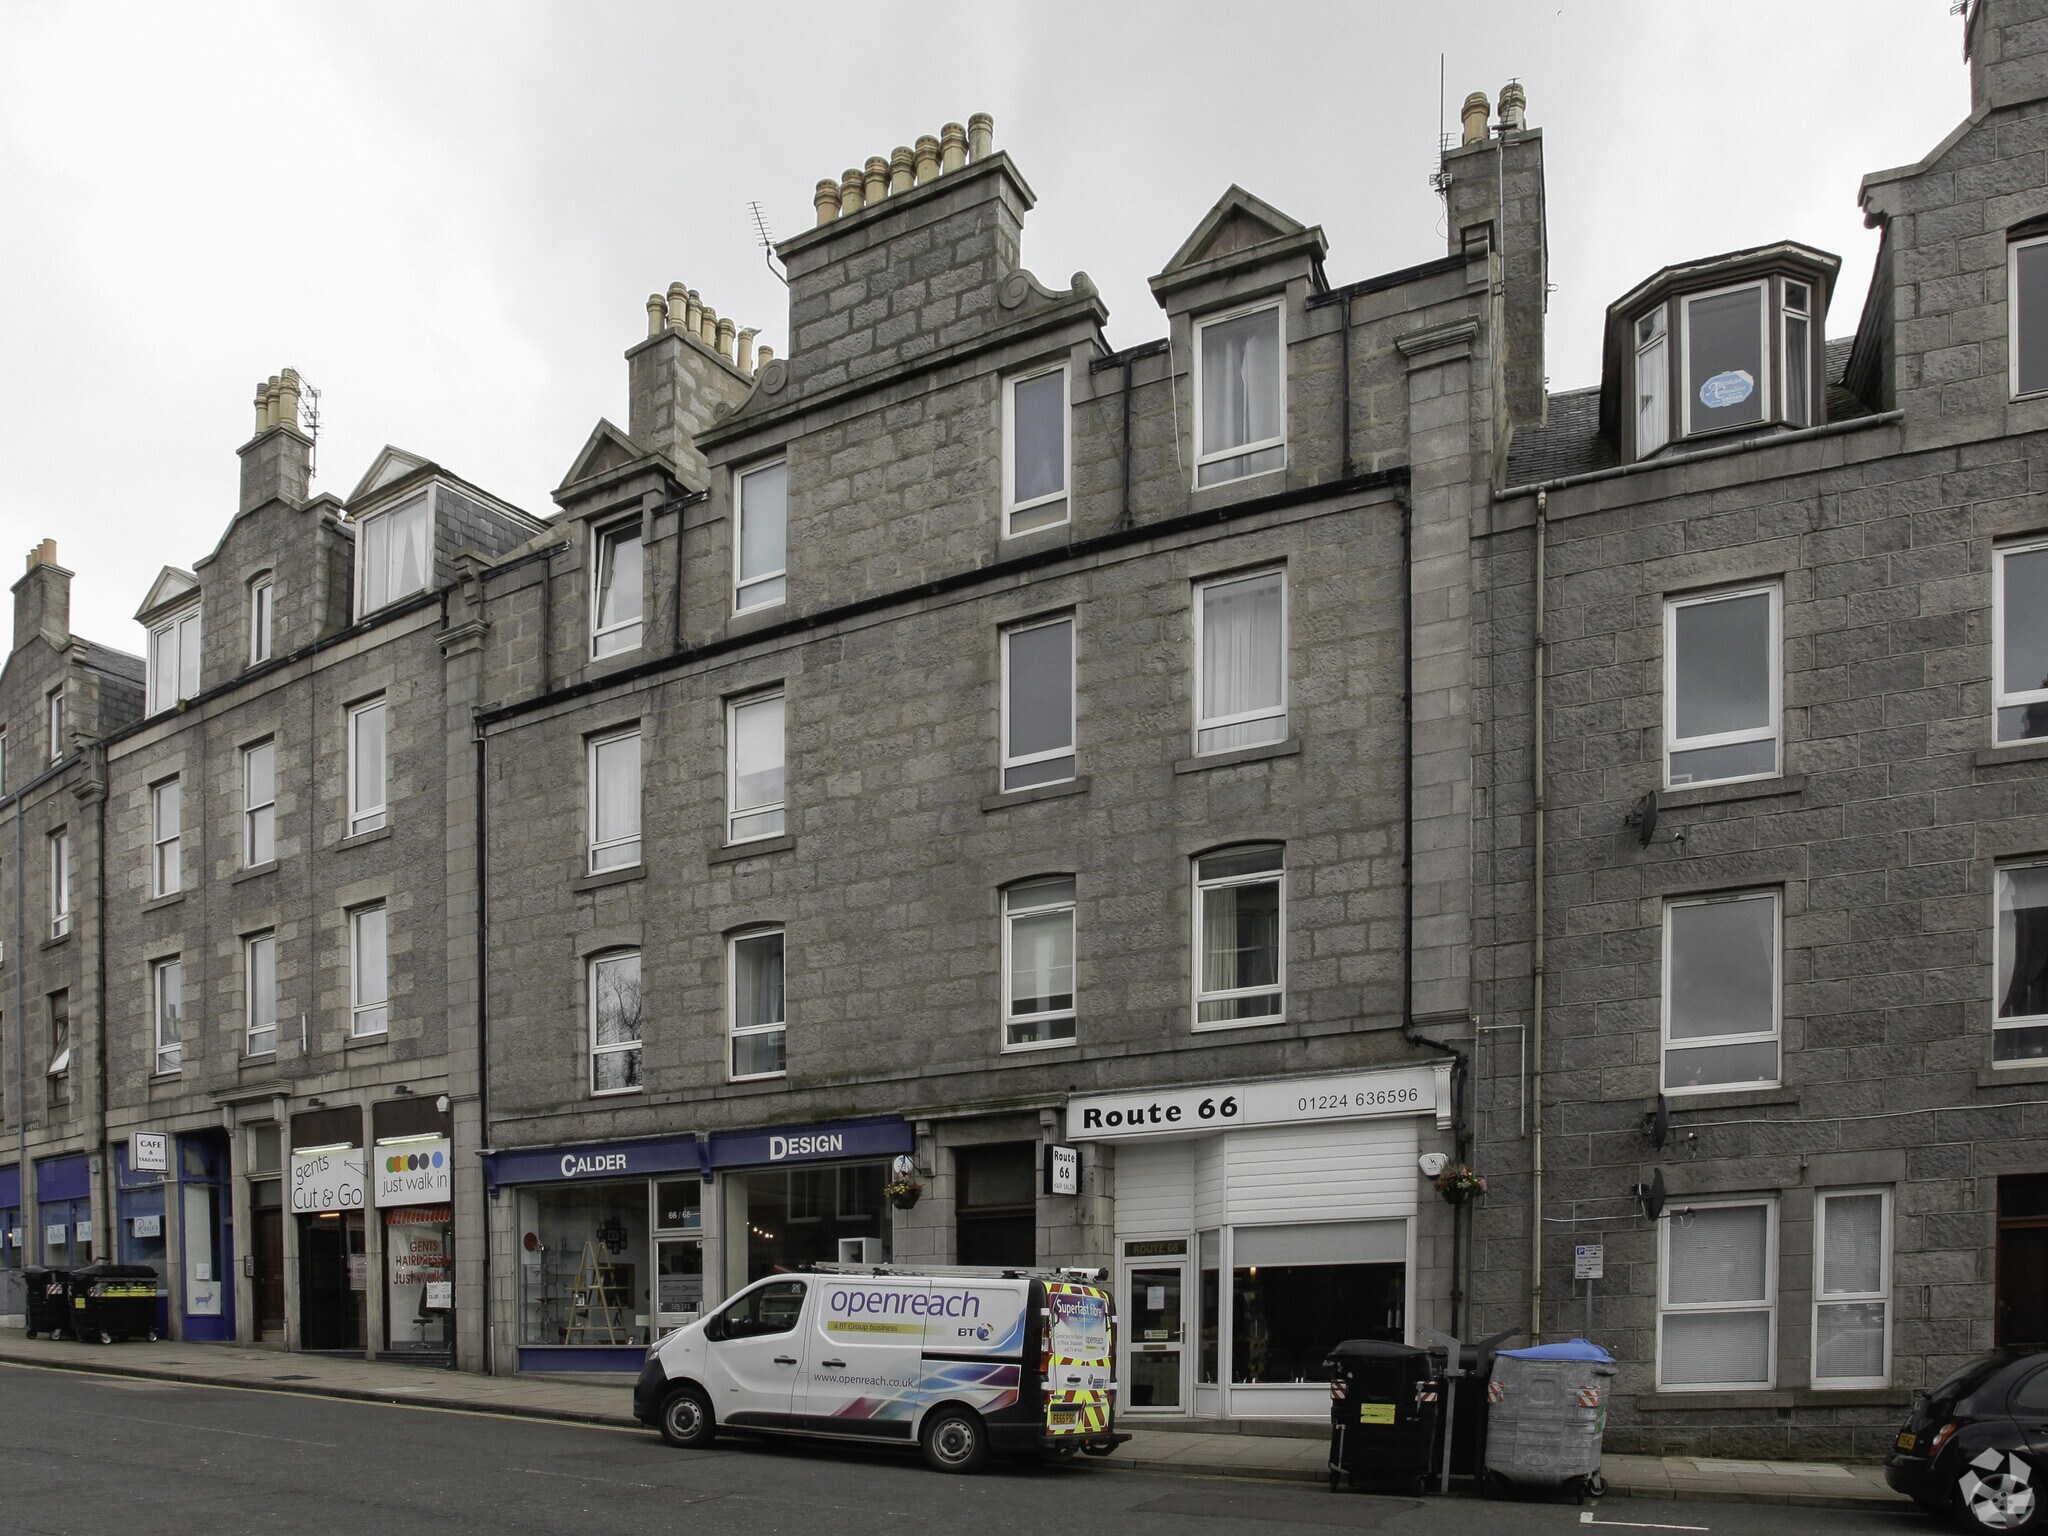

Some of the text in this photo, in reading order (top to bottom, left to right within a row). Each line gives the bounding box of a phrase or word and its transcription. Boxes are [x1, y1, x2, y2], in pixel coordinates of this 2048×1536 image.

[1298, 1088, 1418, 1111] 01224 636596
[1083, 1096, 1238, 1129] Route 66
[140, 1140, 163, 1148] CAFE
[769, 1134, 843, 1160] DESIGN
[1054, 1150, 1075, 1163] Route
[295, 1155, 329, 1185] gents
[560, 1154, 627, 1177] CALDER
[1060, 1166, 1070, 1179] 66
[382, 1172, 447, 1197] just walk in
[293, 1184, 362, 1209] Cut & Go
[668, 1211, 677, 1219] 66
[682, 1210, 691, 1218] 68
[410, 1241, 438, 1252] GENTS
[1133, 1242, 1179, 1254] ROUTE 66
[393, 1271, 414, 1285] Just
[831, 1291, 980, 1317] openreach
[1057, 1299, 1102, 1317] Superfast fibre
[848, 1324, 868, 1332] Group
[869, 1324, 898, 1332] business
[958, 1328, 975, 1337] BT
[813, 1373, 914, 1387] www.openreach.co.uk
